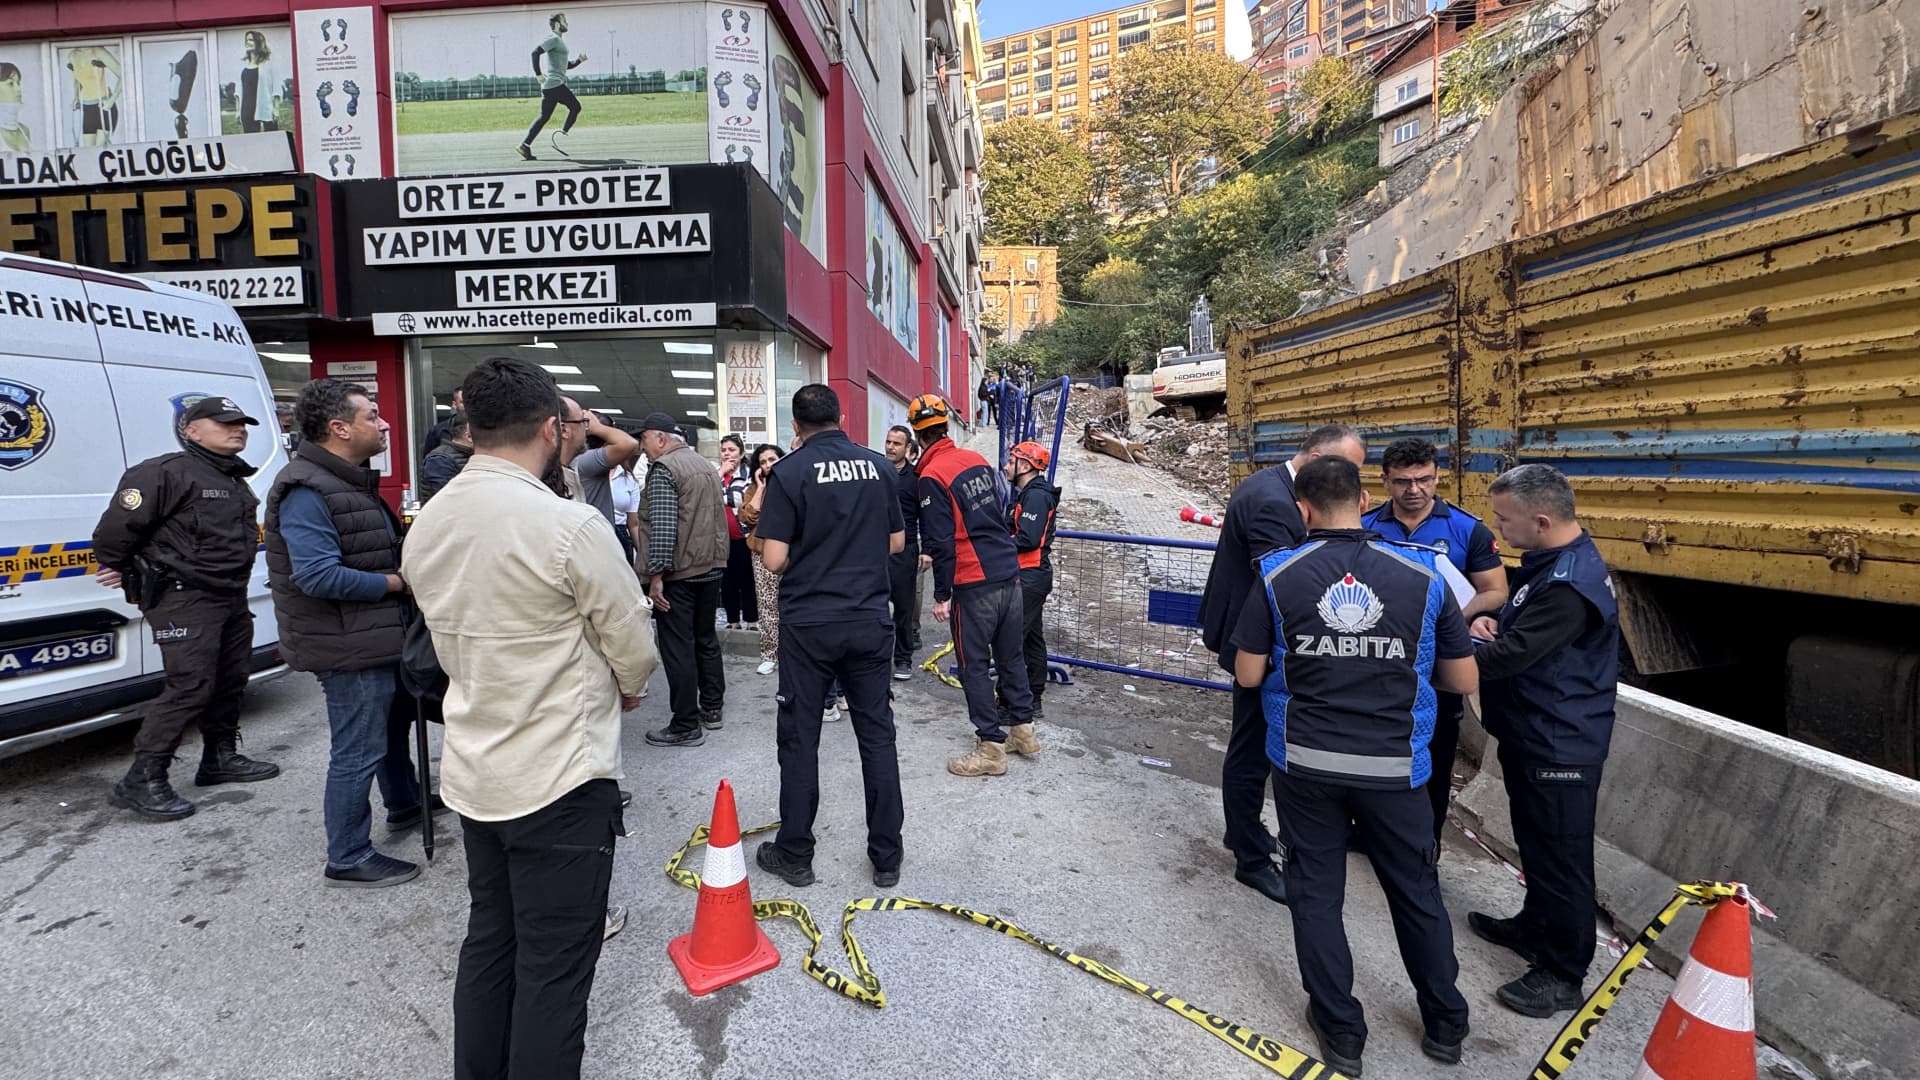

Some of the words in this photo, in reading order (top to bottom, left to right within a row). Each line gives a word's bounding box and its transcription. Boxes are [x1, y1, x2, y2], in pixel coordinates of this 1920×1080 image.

[403, 183, 505, 213] ORTEZ
[536, 174, 662, 206] PROTEZ
[368, 229, 467, 260] YAPIM
[476, 226, 516, 255] VE
[526, 219, 707, 254] UYGULAMA
[207, 278, 240, 300] 502
[246, 277, 268, 298] 22
[273, 276, 296, 297] 22
[424, 306, 692, 330] www.hacettepemedikal.com
[813, 460, 880, 484] ZABITA
[31, 638, 108, 663] 4936
[1295, 634, 1406, 659] ZABITA
